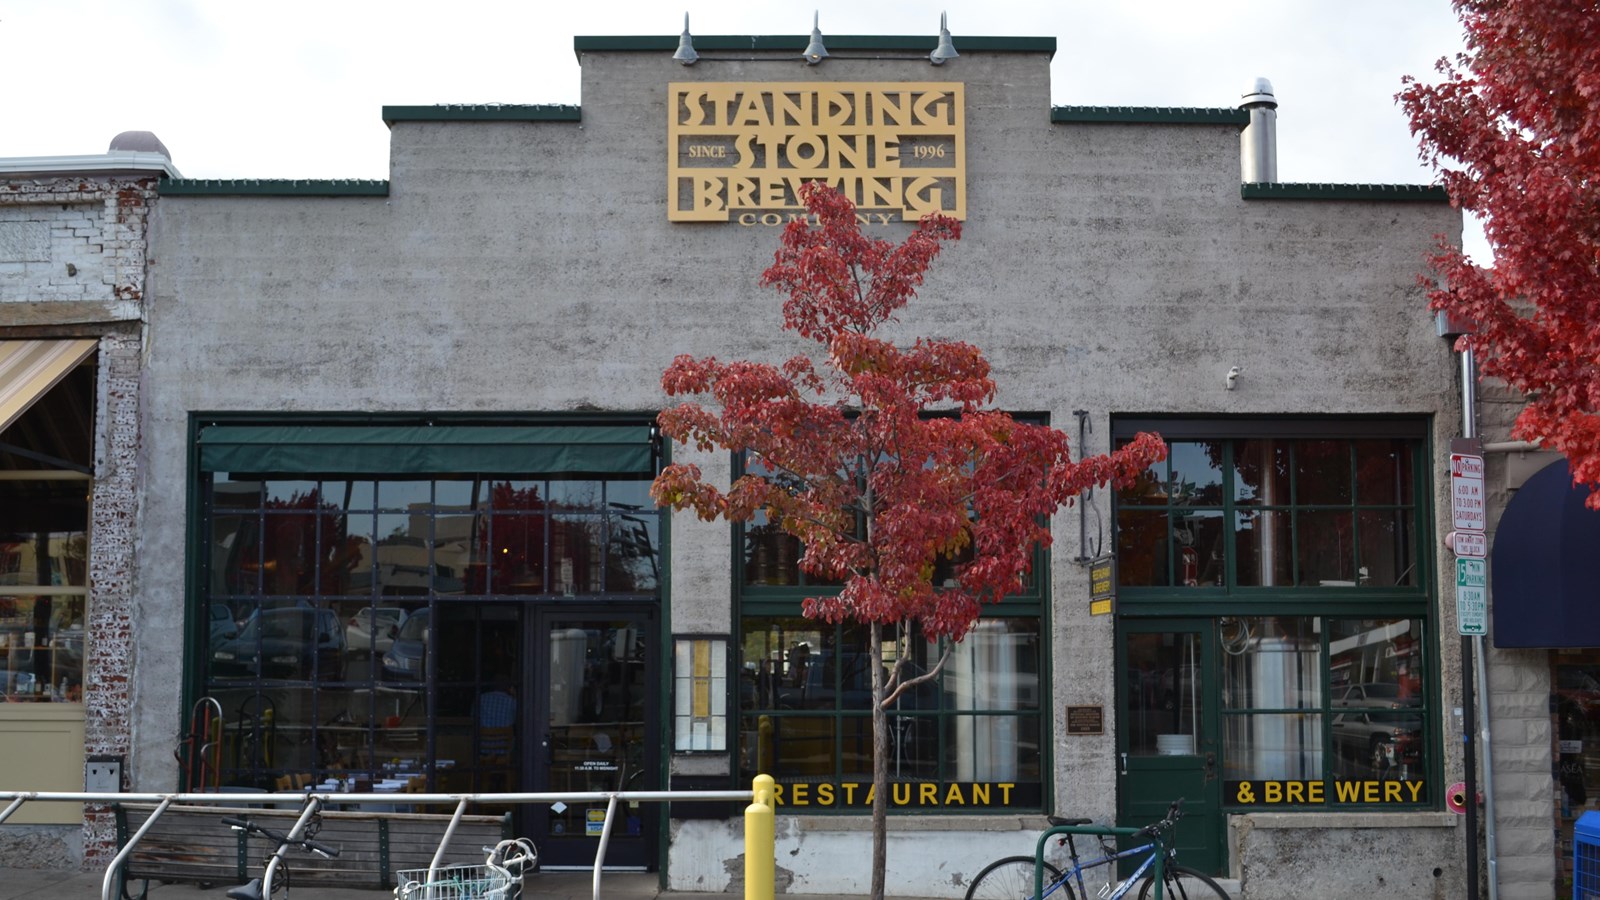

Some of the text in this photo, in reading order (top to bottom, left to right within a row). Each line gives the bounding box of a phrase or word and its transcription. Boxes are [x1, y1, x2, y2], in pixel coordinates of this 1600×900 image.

[682, 91, 948, 126] STANDING
[689, 145, 726, 158] SINCE
[733, 134, 901, 169] STONE
[913, 145, 945, 159] 1996
[738, 212, 895, 226] COMNY
[1453, 459, 1481, 474] NO PARKING
[1471, 486, 1479, 496] AM
[1456, 497, 1463, 508] TO
[1474, 499, 1482, 509] PM
[1455, 510, 1482, 522] SATURDAYS
[1457, 563, 1466, 583] 15
[1471, 564, 1480, 572] MIN
[1466, 575, 1484, 585] PARKING
[1237, 781, 1256, 803] &
